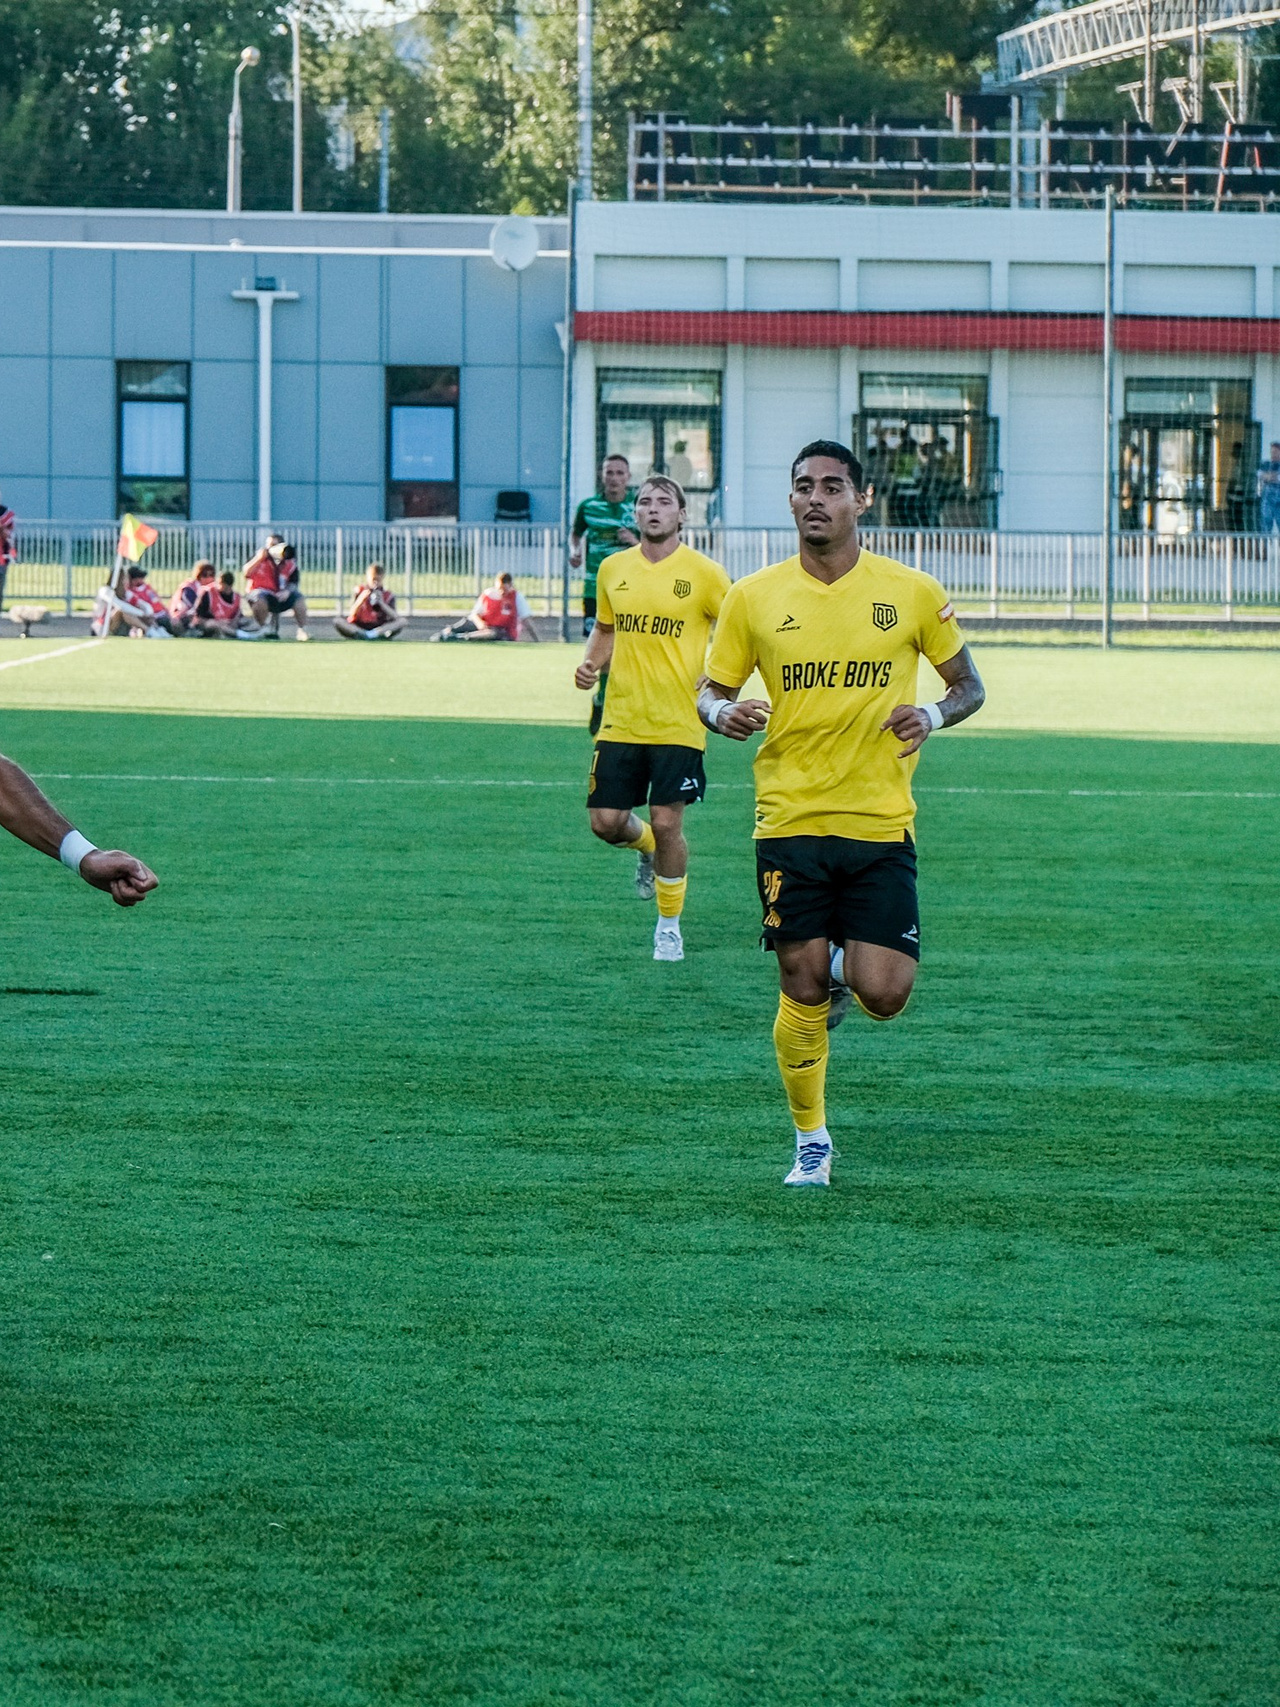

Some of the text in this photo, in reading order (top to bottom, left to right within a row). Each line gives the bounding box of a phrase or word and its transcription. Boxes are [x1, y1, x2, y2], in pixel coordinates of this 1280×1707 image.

[615, 613, 685, 638] BROKE BOYS
[775, 625, 802, 633] DEMIX
[782, 661, 892, 692] BROKE BOYS
